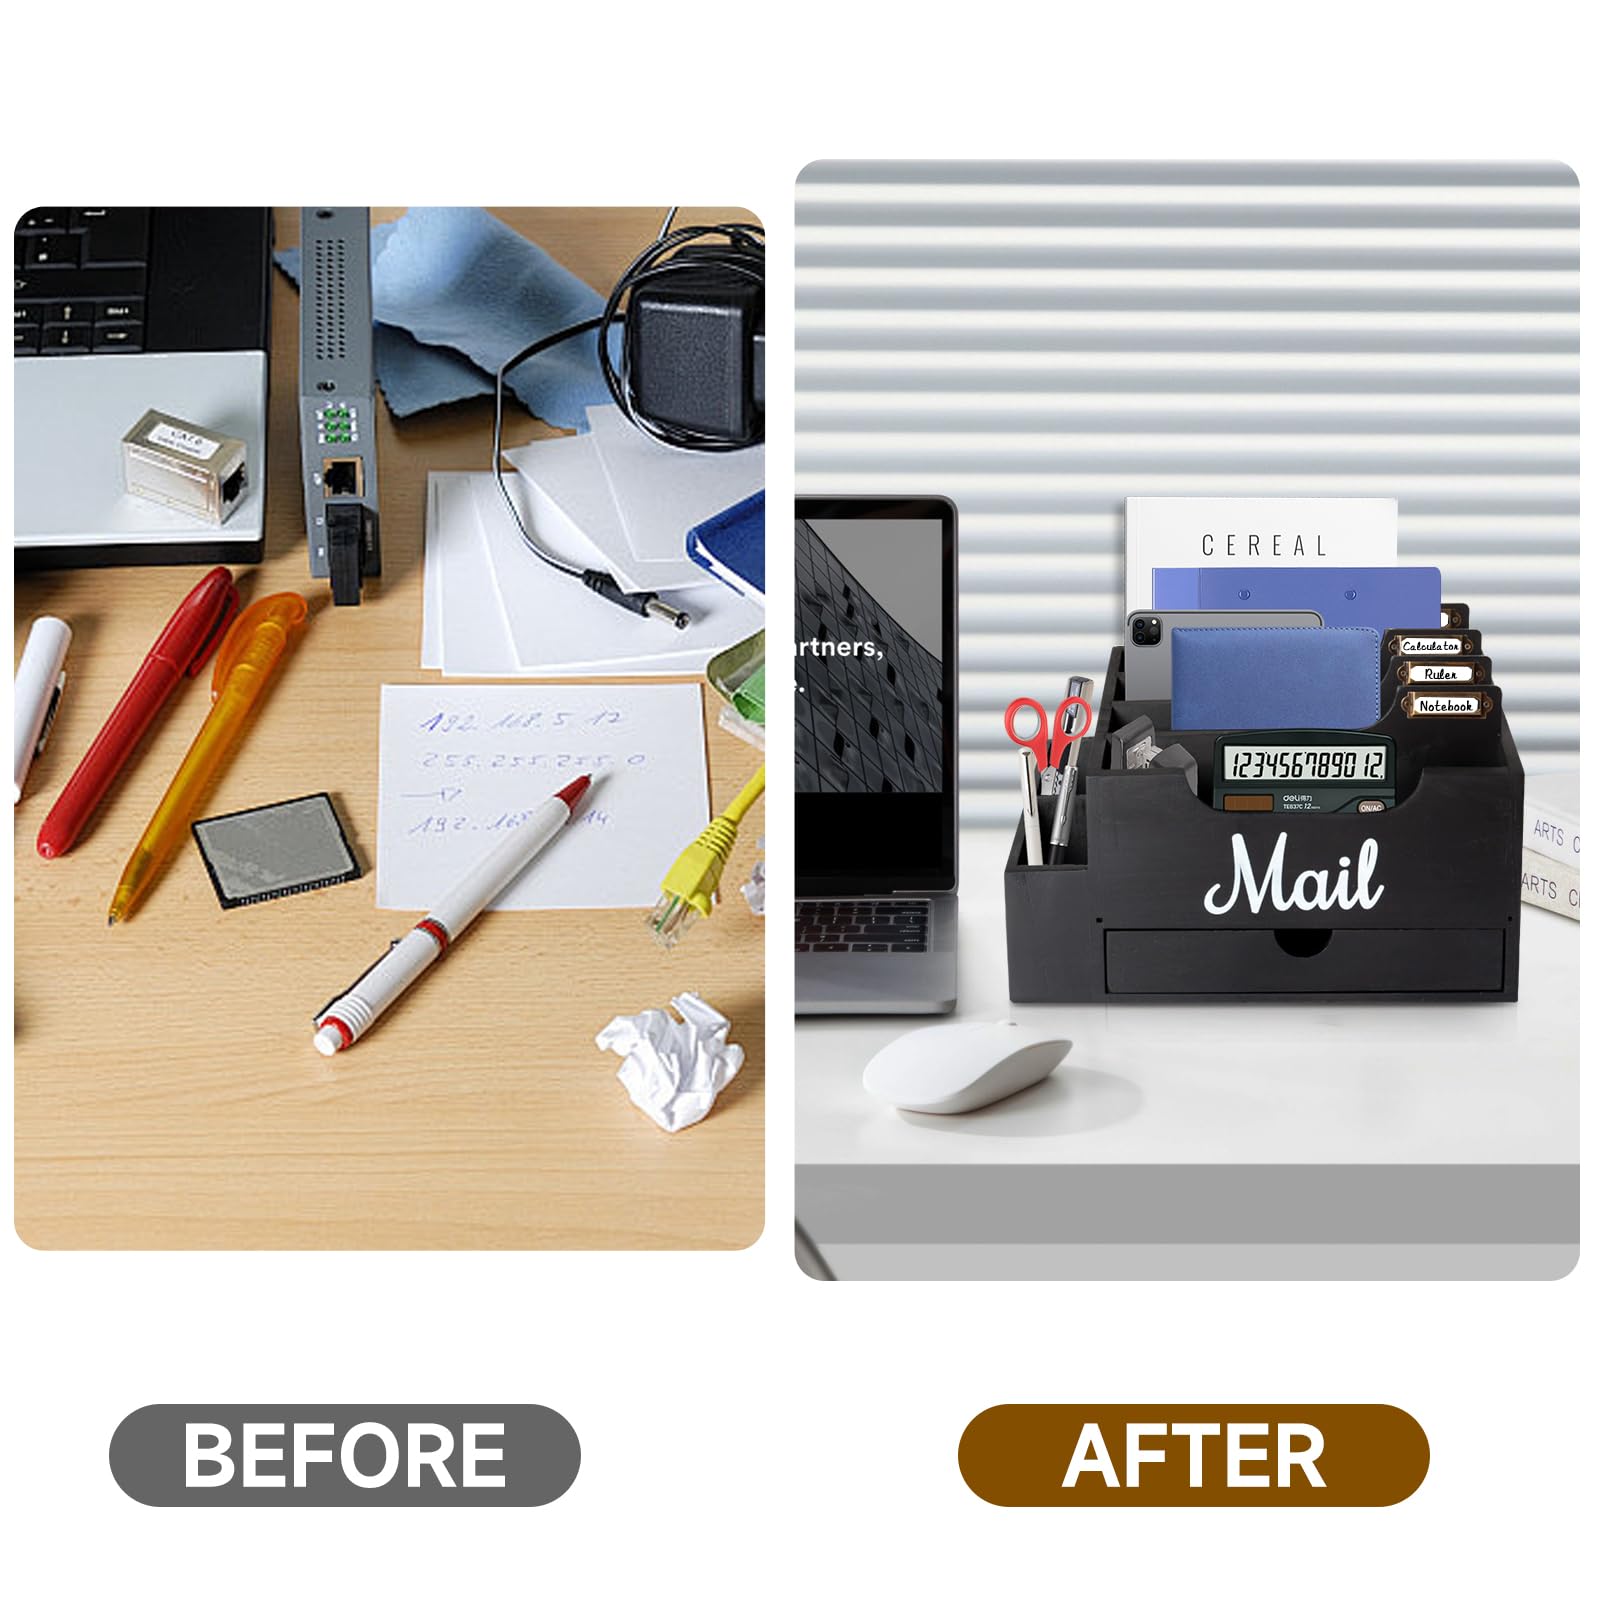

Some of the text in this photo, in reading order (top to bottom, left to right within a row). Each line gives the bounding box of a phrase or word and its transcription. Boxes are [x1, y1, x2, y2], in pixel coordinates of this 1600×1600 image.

[1202, 534, 1326, 557] CEREAL
[795, 637, 883, 661] rtners,
[1403, 641, 1459, 651] Calculator
[1424, 668, 1457, 680] Ruler
[1420, 700, 1473, 712] Notebook
[1533, 819, 1565, 847] ARTS
[1203, 831, 1385, 915] Mail
[1521, 872, 1558, 900] ARTS
